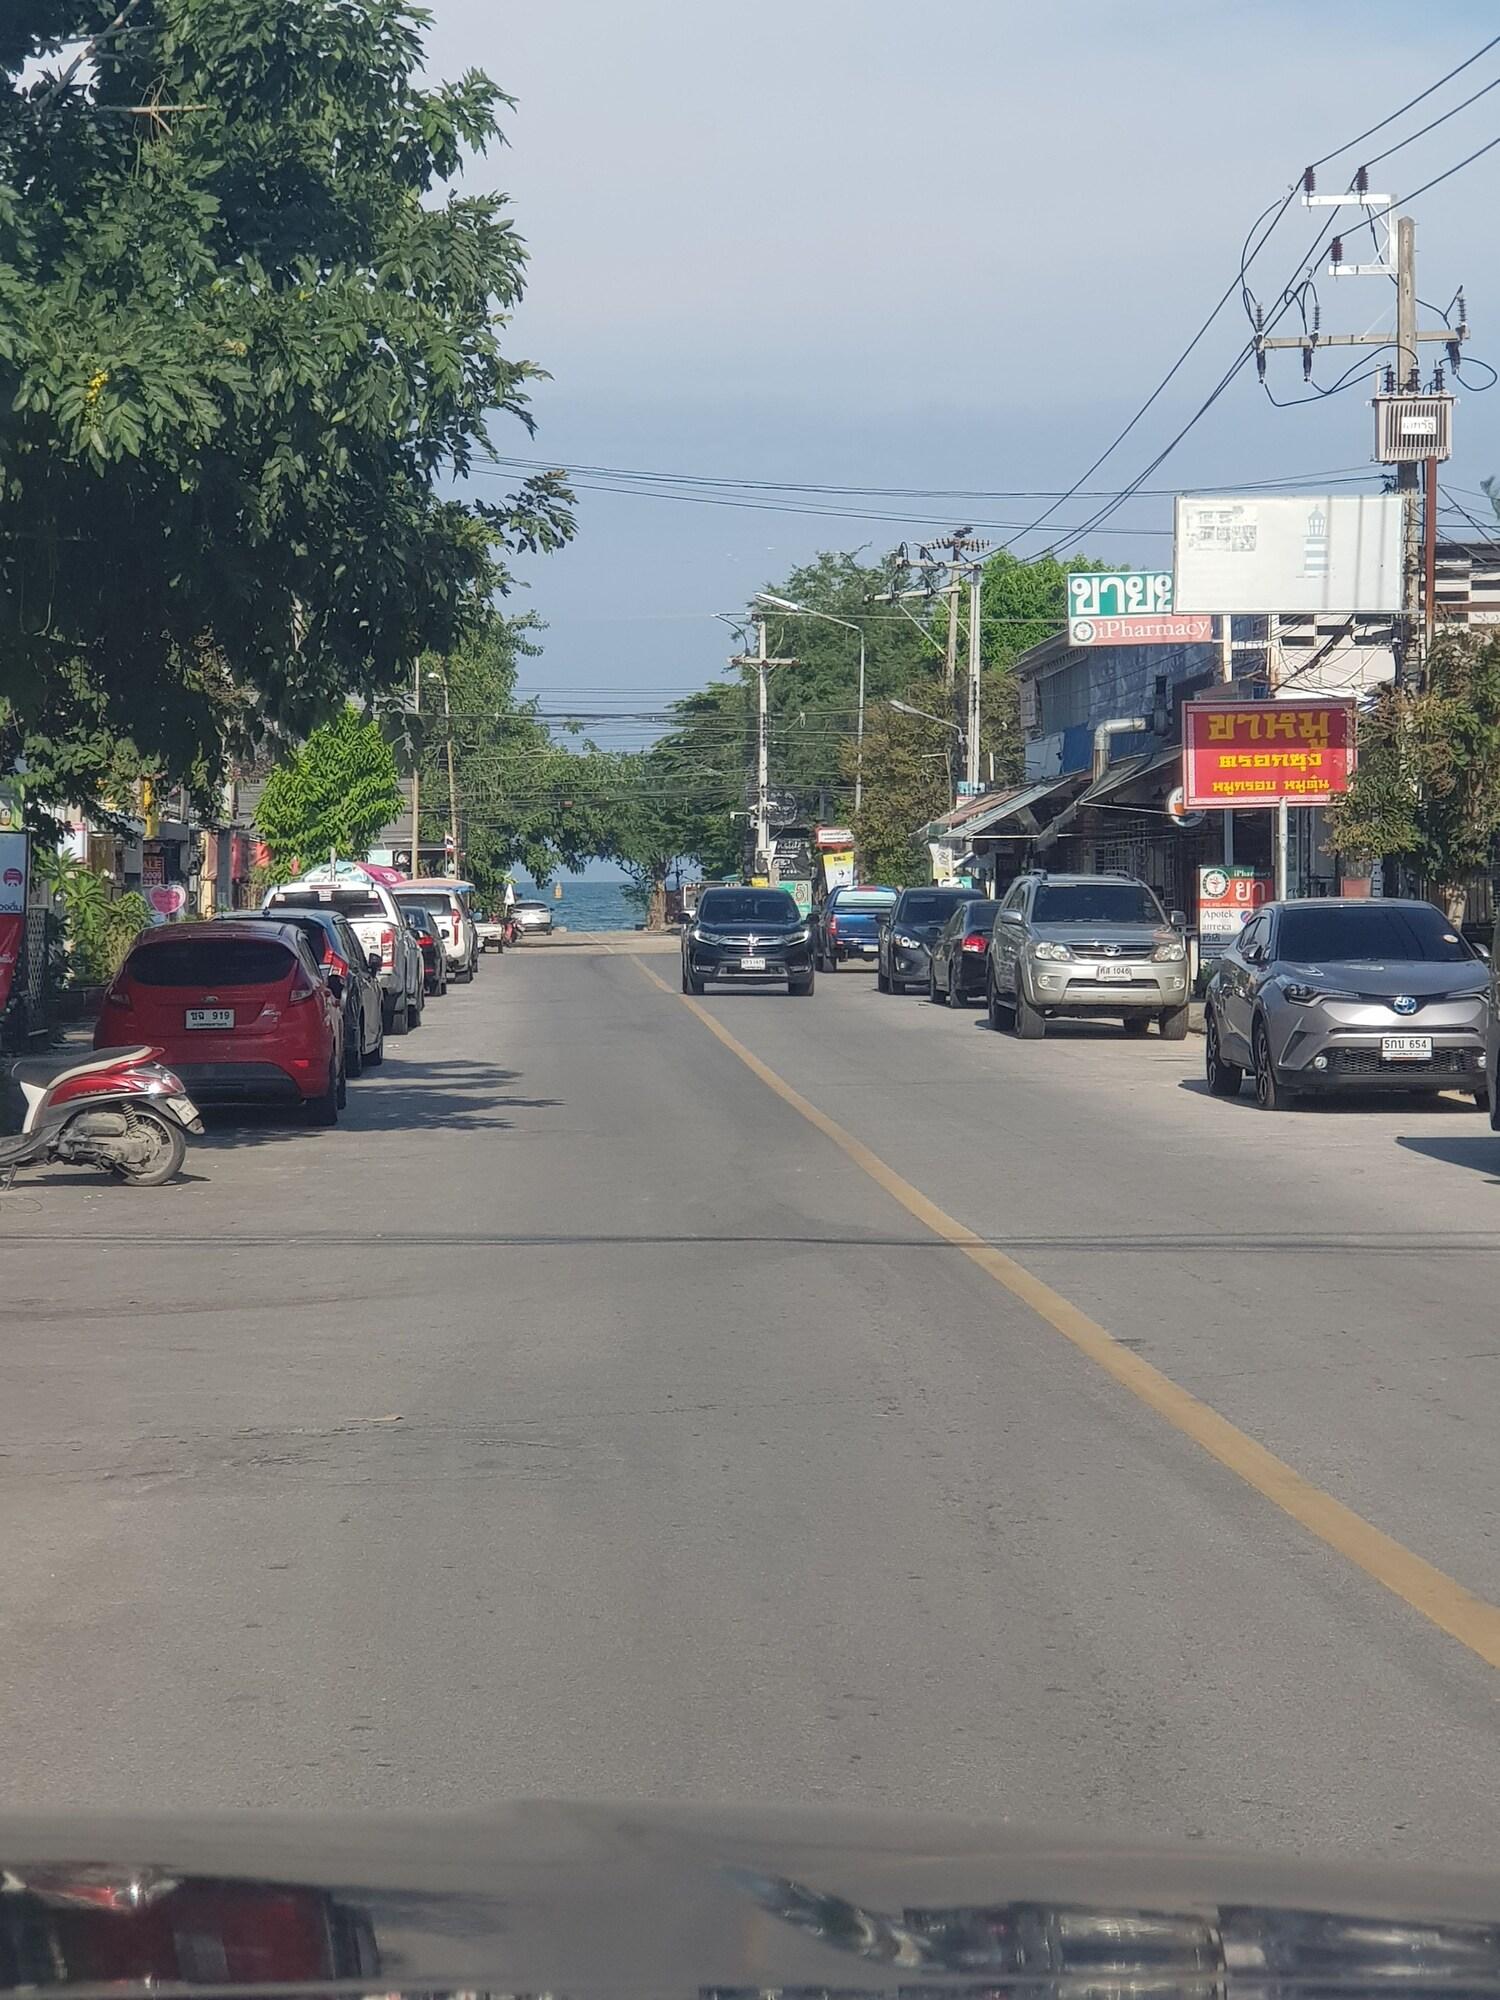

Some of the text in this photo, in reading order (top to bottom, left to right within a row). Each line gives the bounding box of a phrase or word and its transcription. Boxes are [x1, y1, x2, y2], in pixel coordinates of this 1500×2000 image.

[1099, 620, 1209, 638] iPharmacy
[1208, 712, 1330, 749] ขาหมู
[1212, 780, 1276, 795] หมูกรอบ
[1235, 881, 1266, 901] ยา
[1203, 910, 1234, 920] Apotek
[212, 1012, 230, 1020] 919
[1409, 1039, 1427, 1049] 654
